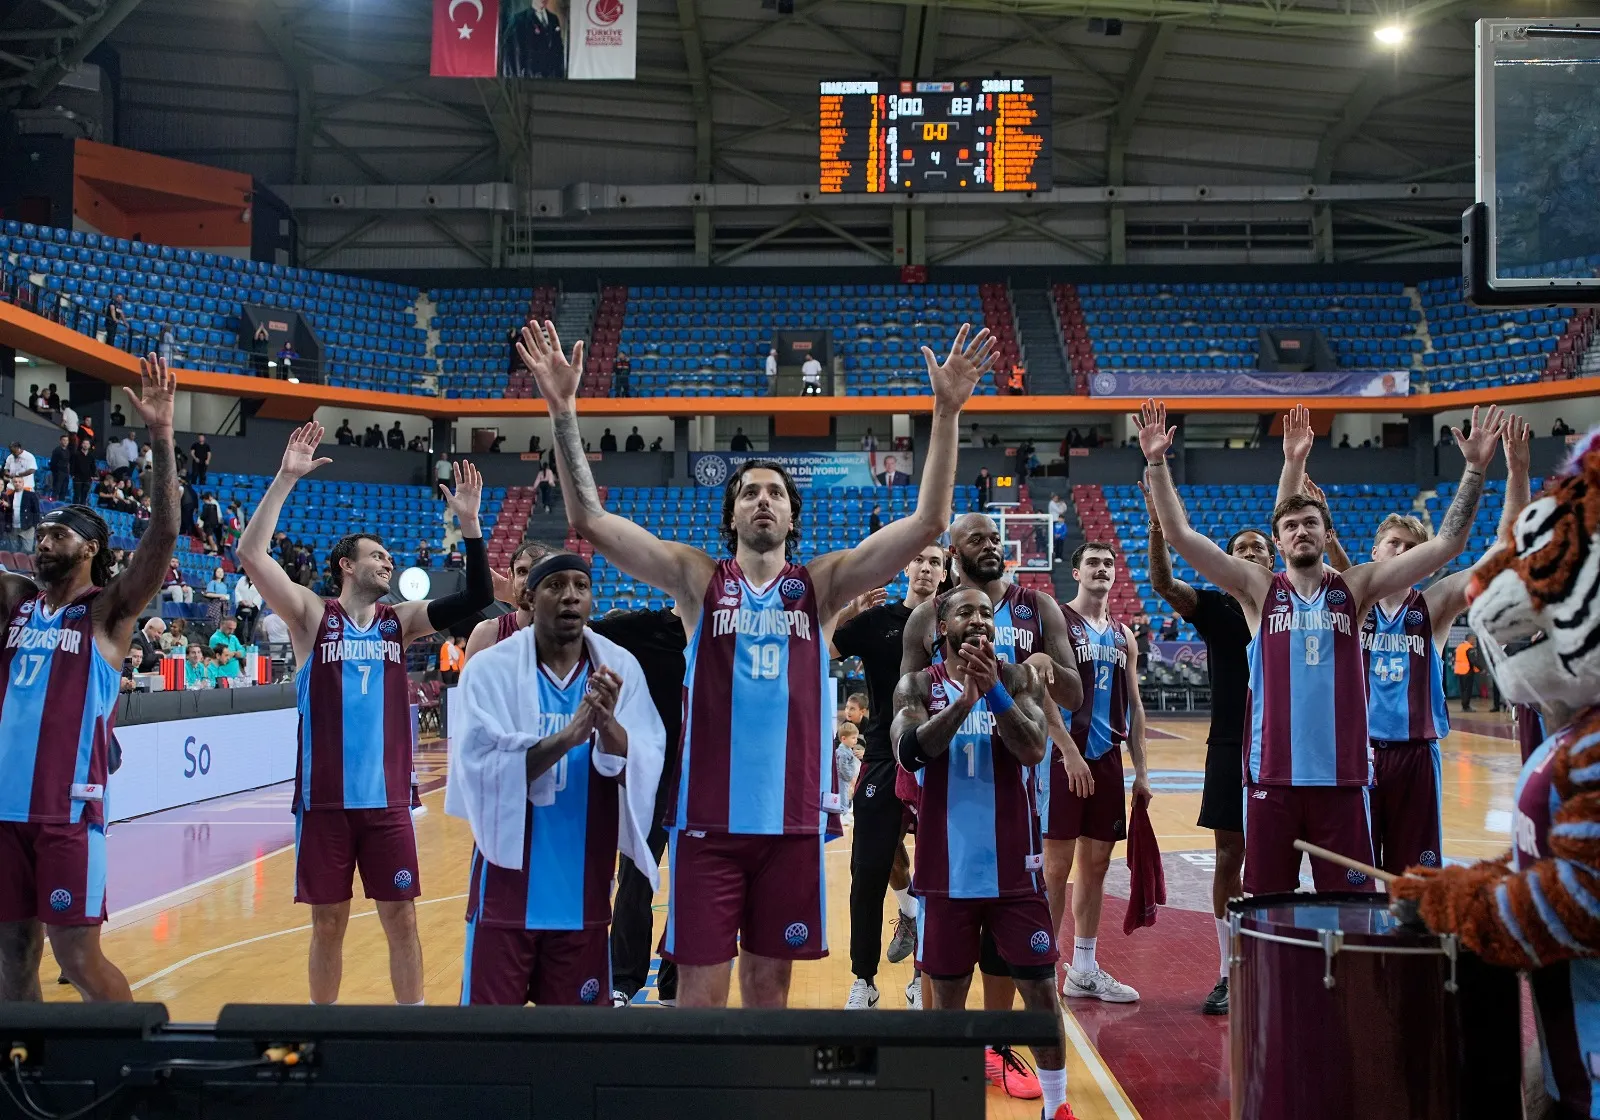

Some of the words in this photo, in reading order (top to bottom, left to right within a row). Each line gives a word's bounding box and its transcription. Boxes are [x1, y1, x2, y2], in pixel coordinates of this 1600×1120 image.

[585, 28, 623, 36] TÜRKİYE
[898, 98, 923, 116] 100
[951, 97, 973, 115] 83
[930, 151, 941, 165] 4
[729, 456, 746, 465] TÜM
[789, 457, 799, 465] VE
[799, 465, 849, 475] DİLİYORUM
[713, 608, 811, 640] TRABZONSPOR
[1268, 609, 1352, 636] TRABZONSPOR
[320, 639, 401, 665] TRABZONSPOR
[747, 643, 780, 680] 19
[1305, 635, 1320, 666] 8
[14, 654, 46, 687] 17
[357, 665, 372, 695] 7
[1374, 657, 1404, 682] 45
[184, 735, 211, 779] So
[962, 742, 975, 778] 1
